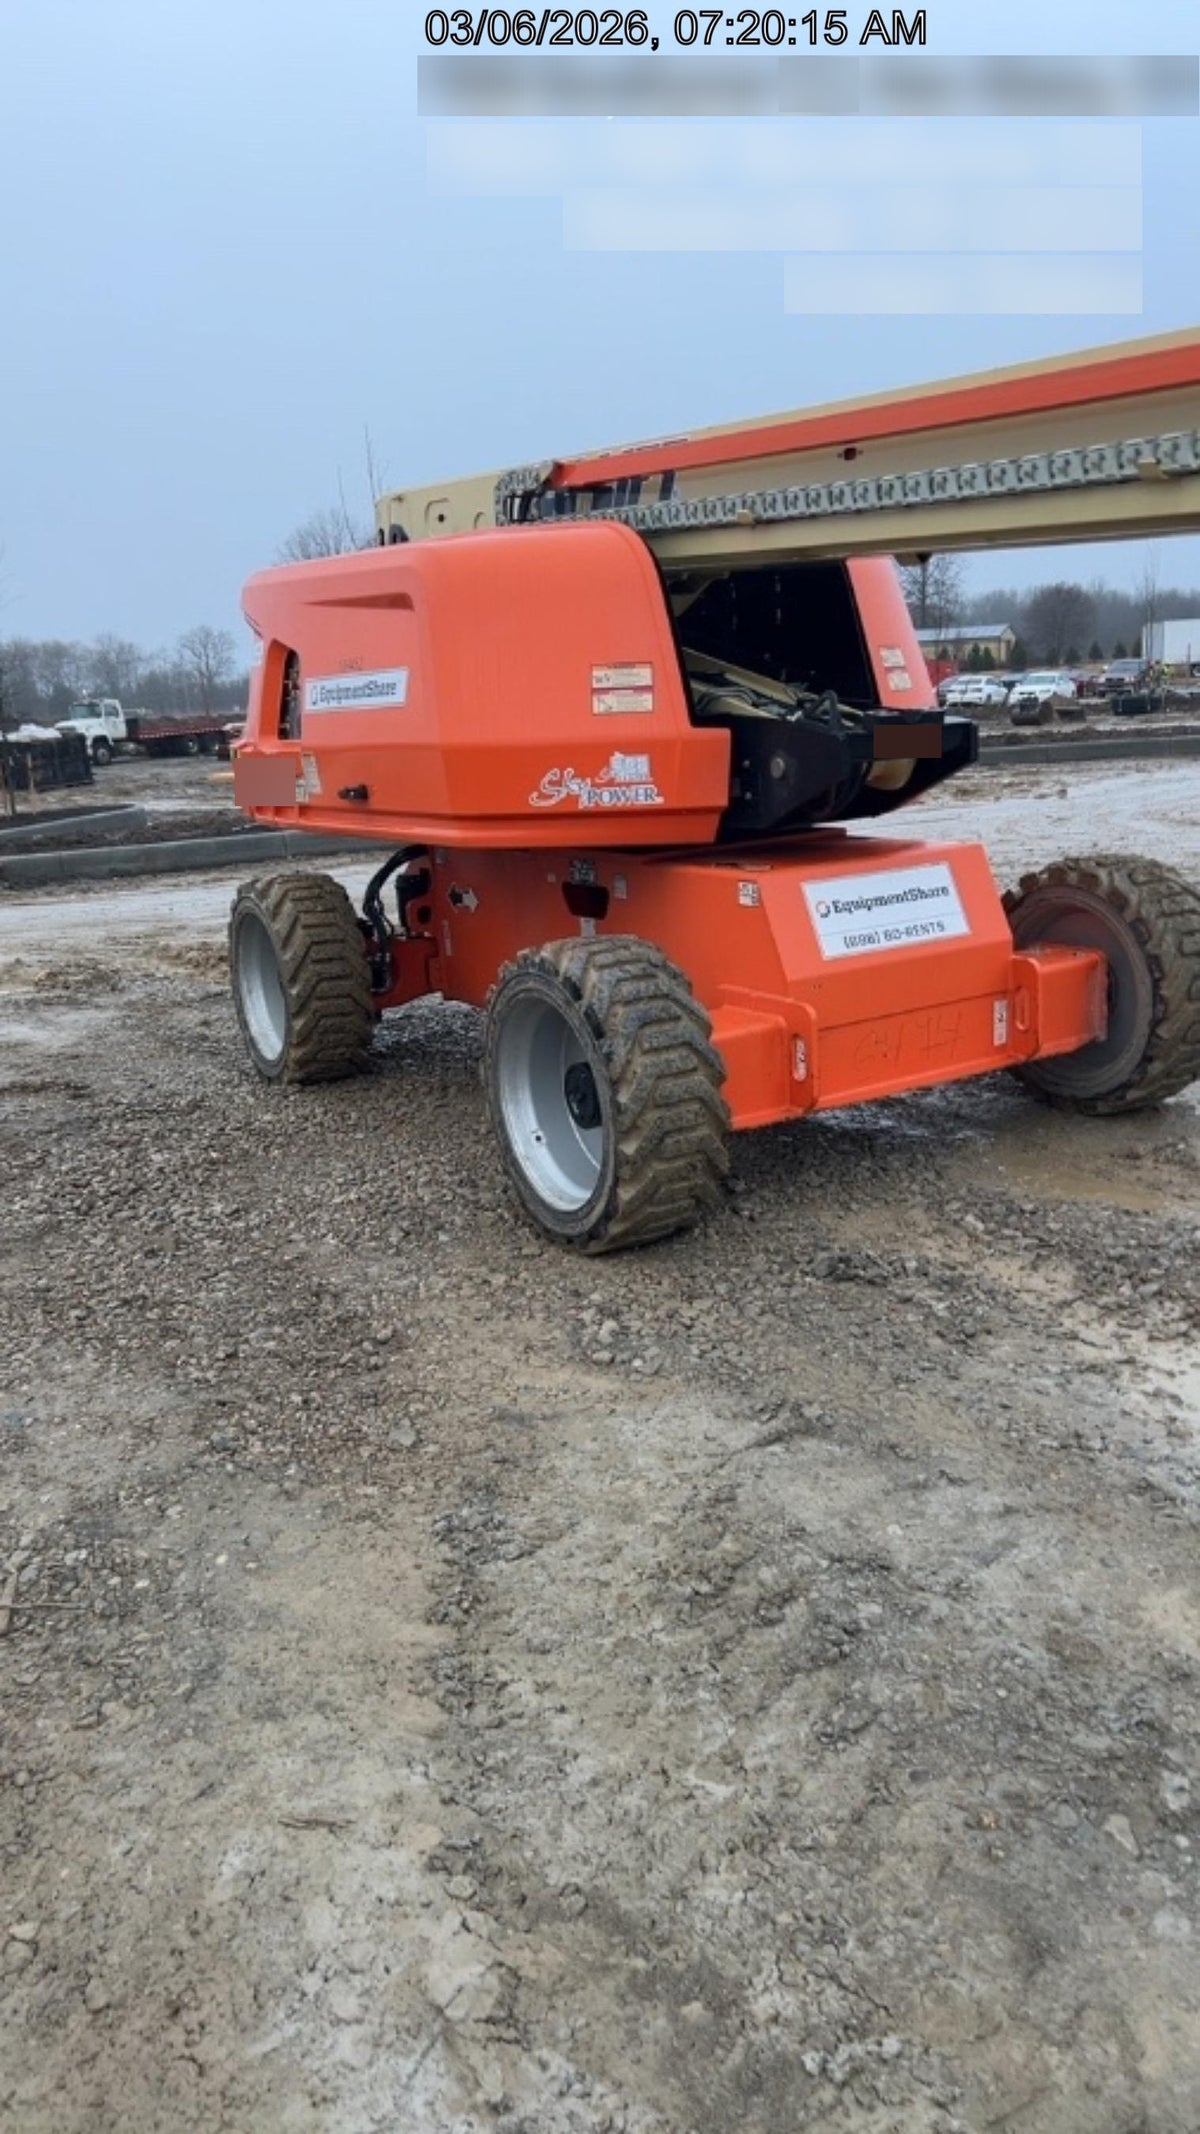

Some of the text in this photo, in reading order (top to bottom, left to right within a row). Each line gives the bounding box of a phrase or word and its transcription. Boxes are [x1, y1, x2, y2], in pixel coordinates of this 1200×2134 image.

[319, 680, 397, 704] EquipmentShare
[584, 784, 657, 806] POWER
[831, 886, 950, 916] EquipmentShare
